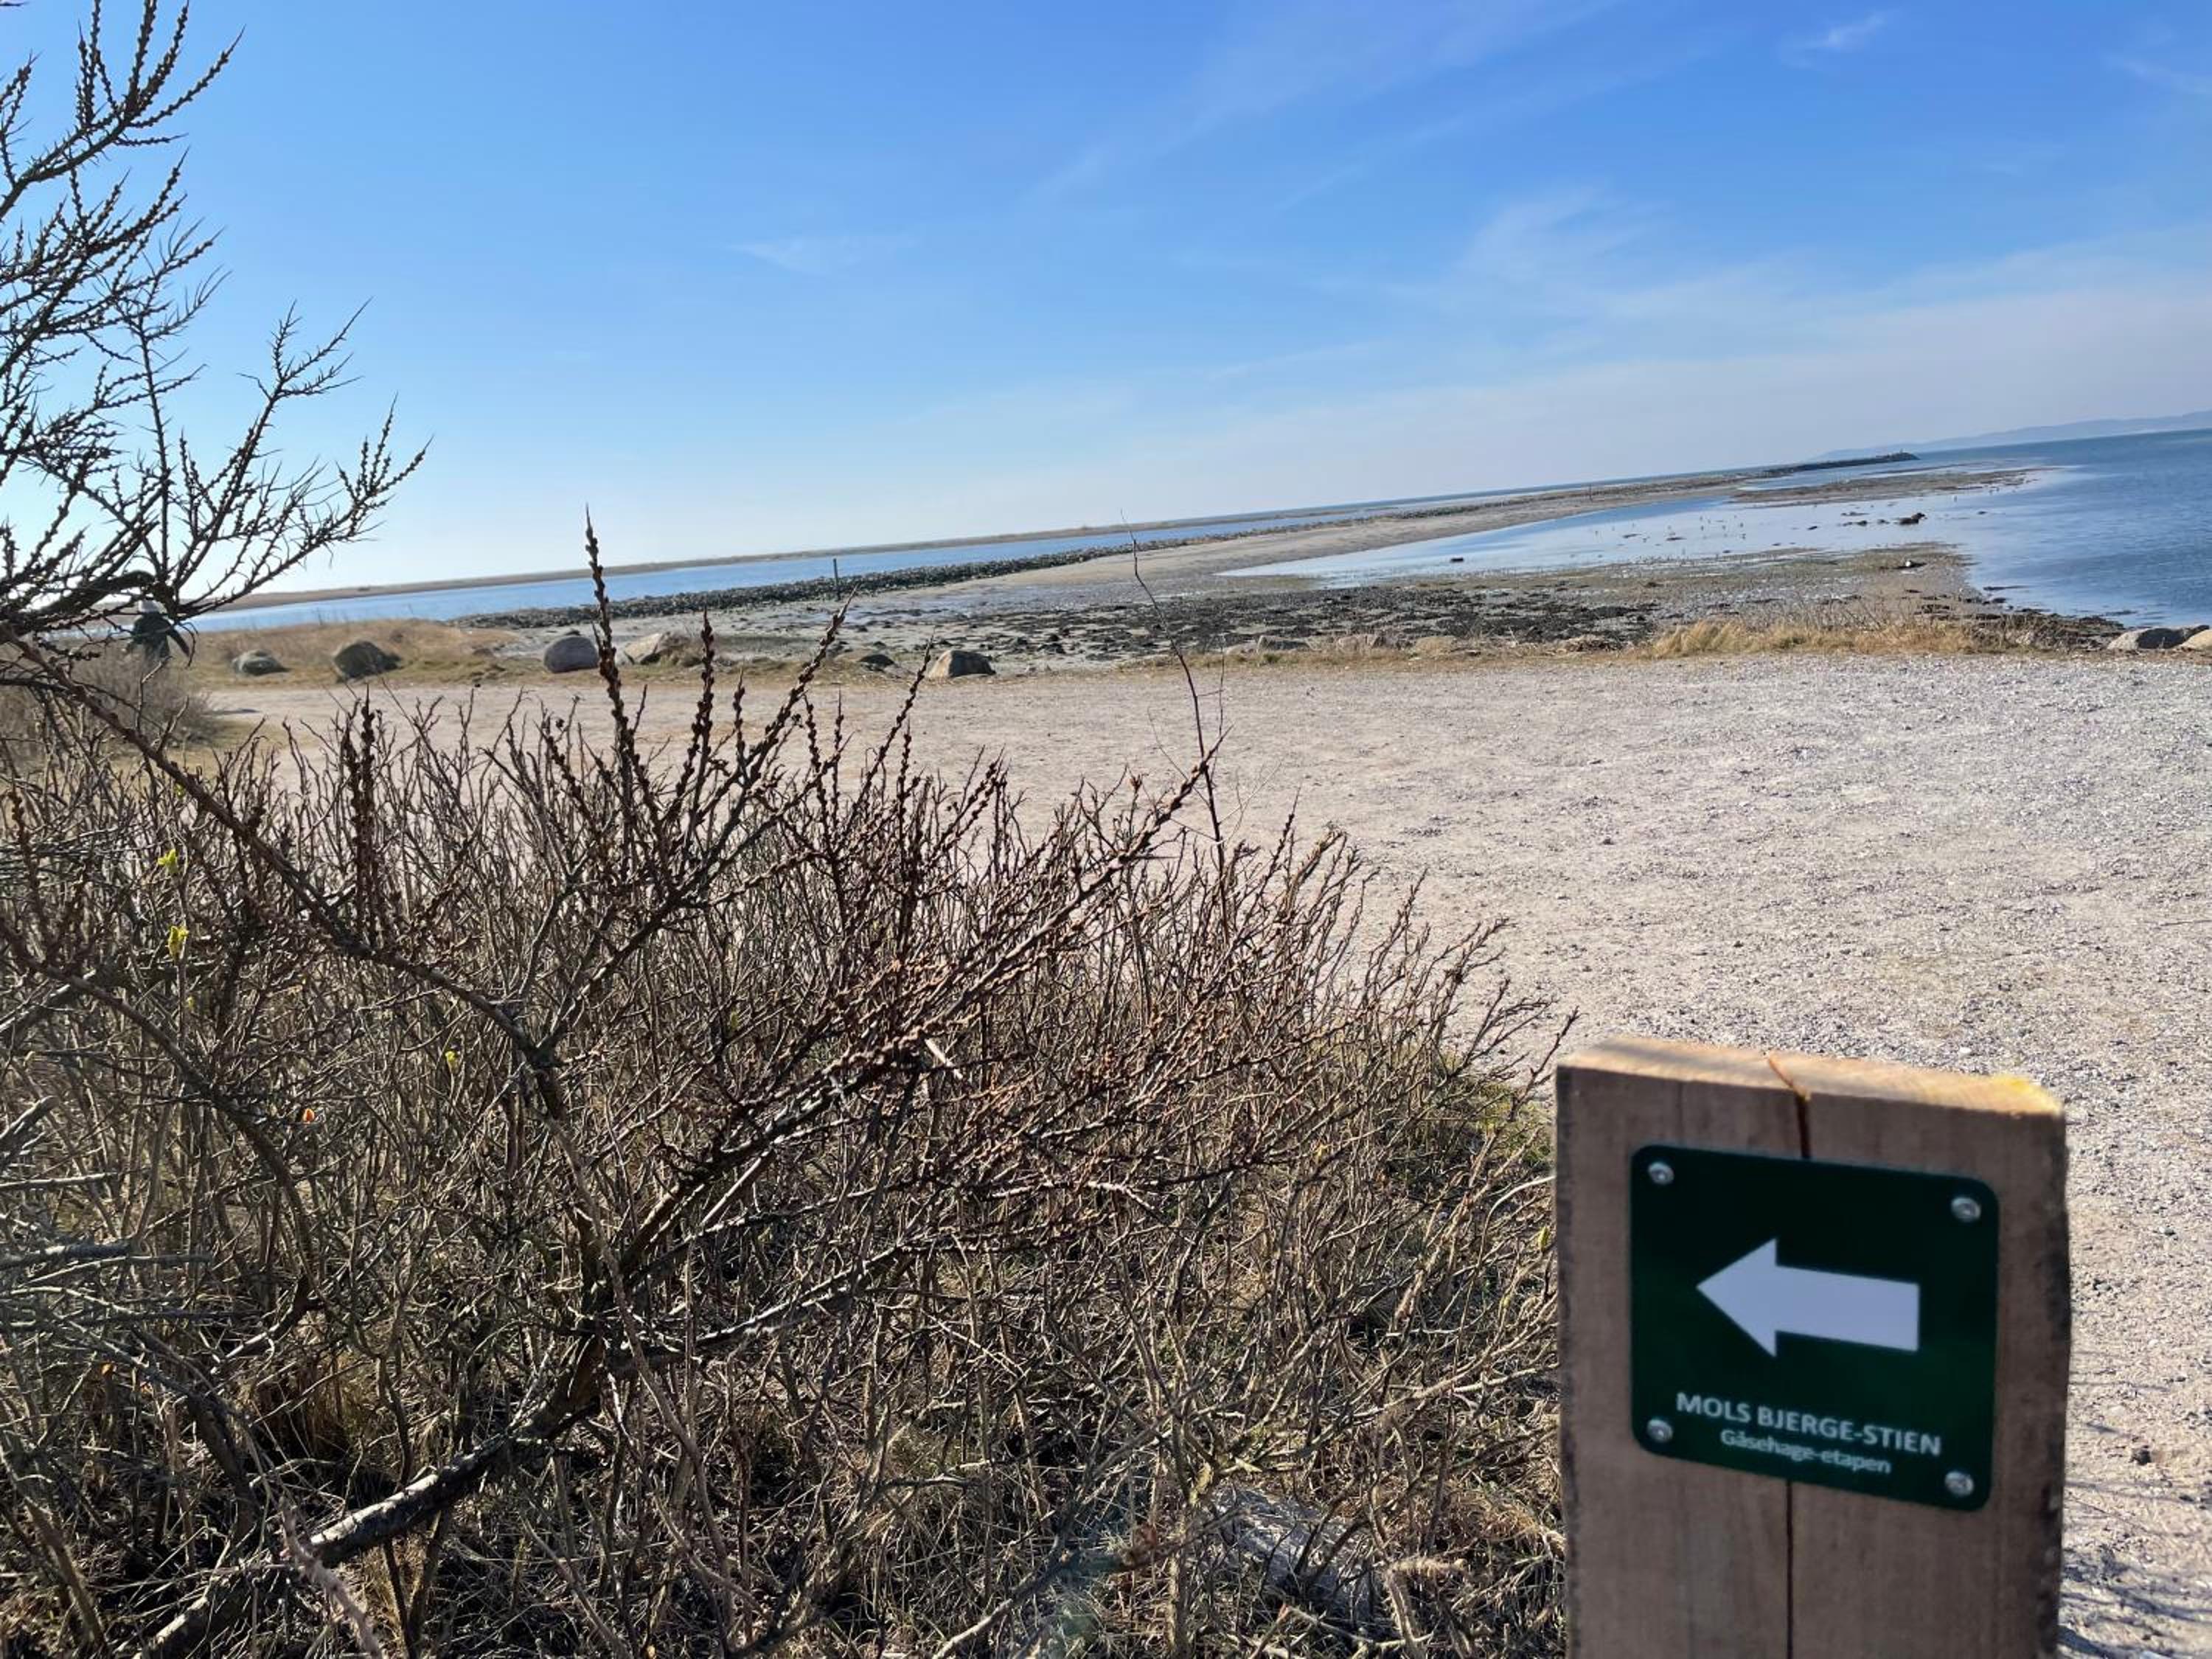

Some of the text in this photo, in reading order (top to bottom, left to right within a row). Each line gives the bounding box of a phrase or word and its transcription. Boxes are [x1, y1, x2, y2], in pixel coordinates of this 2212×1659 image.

[1676, 1392, 1941, 1456] MOLS BJERGE-STIEN
[1720, 1429, 1891, 1473] Gåsehage-etapen
